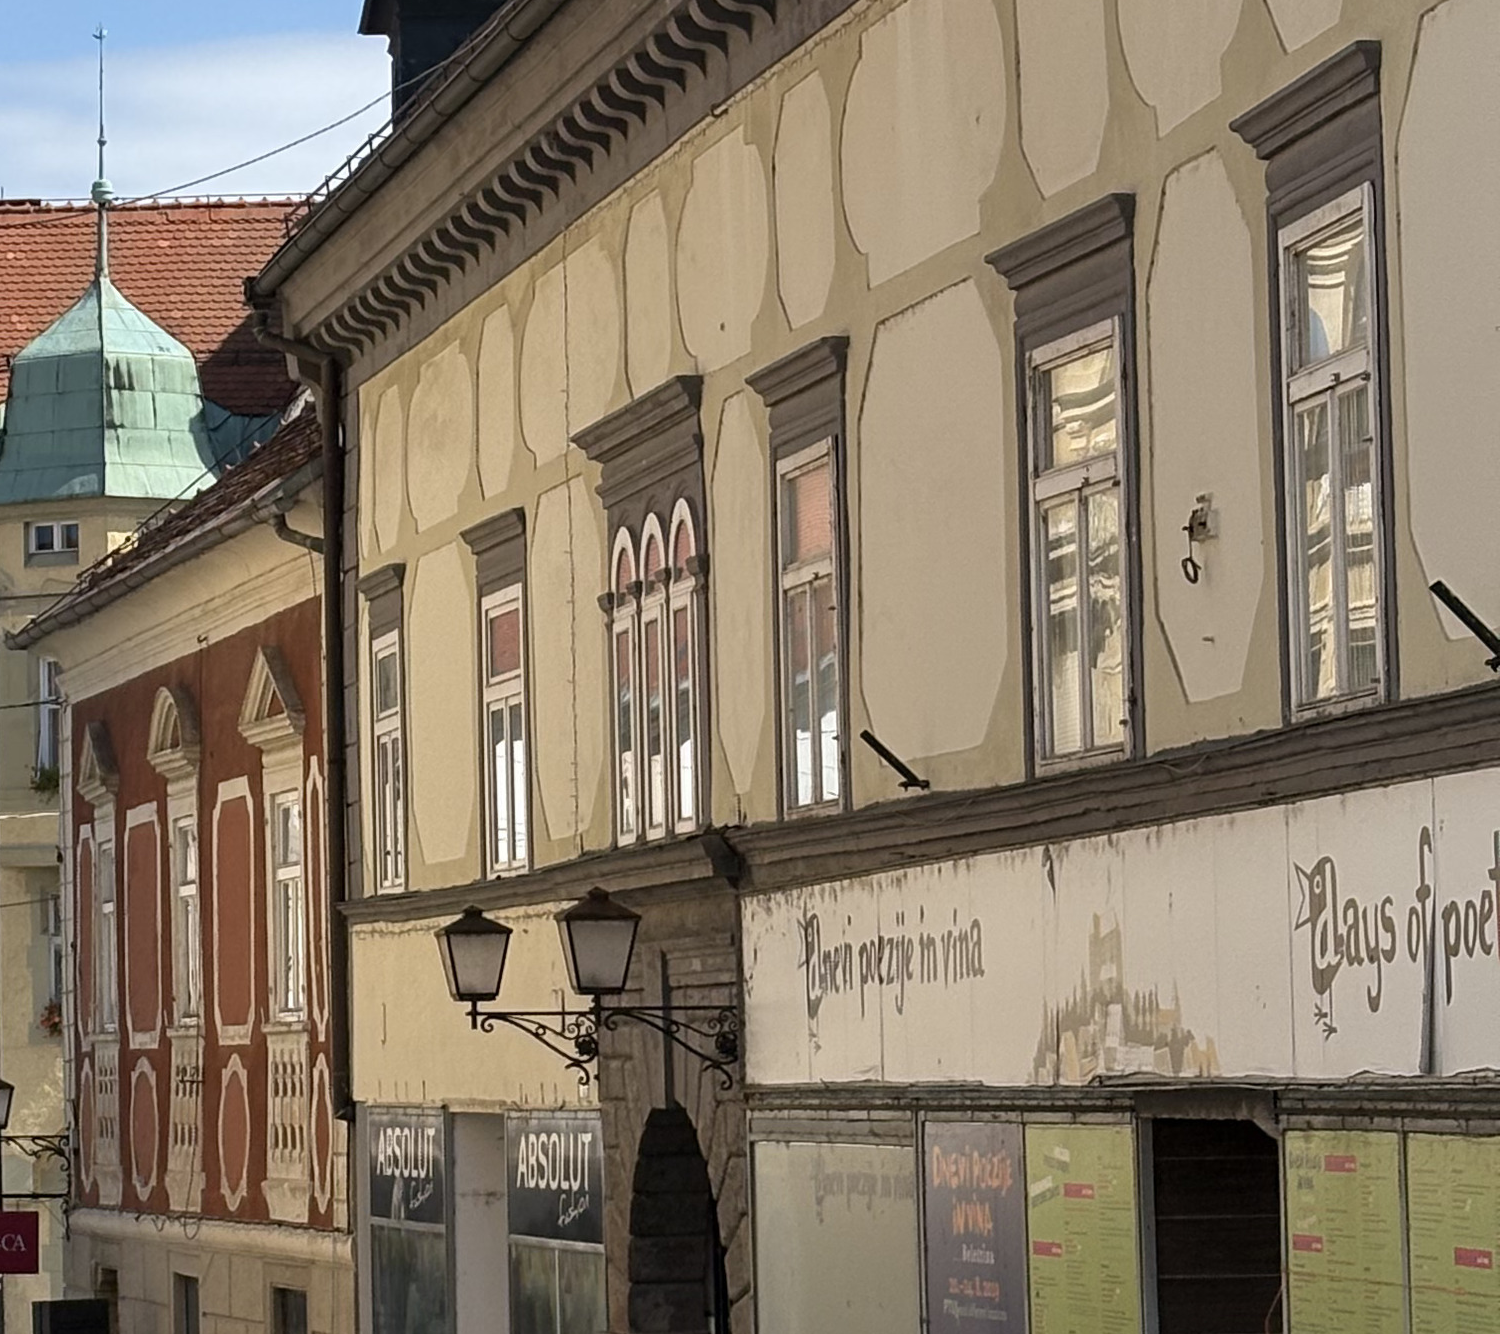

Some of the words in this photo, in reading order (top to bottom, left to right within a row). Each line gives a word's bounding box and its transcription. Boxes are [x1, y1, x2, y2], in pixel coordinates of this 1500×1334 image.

[858, 910, 915, 1019] poezije
[919, 905, 938, 985] in
[941, 908, 986, 990] vina
[1309, 855, 1397, 1013] days
[1407, 825, 1433, 977] of
[376, 1126, 436, 1179] ABSOLUT
[516, 1132, 592, 1191] ABSOLUT
